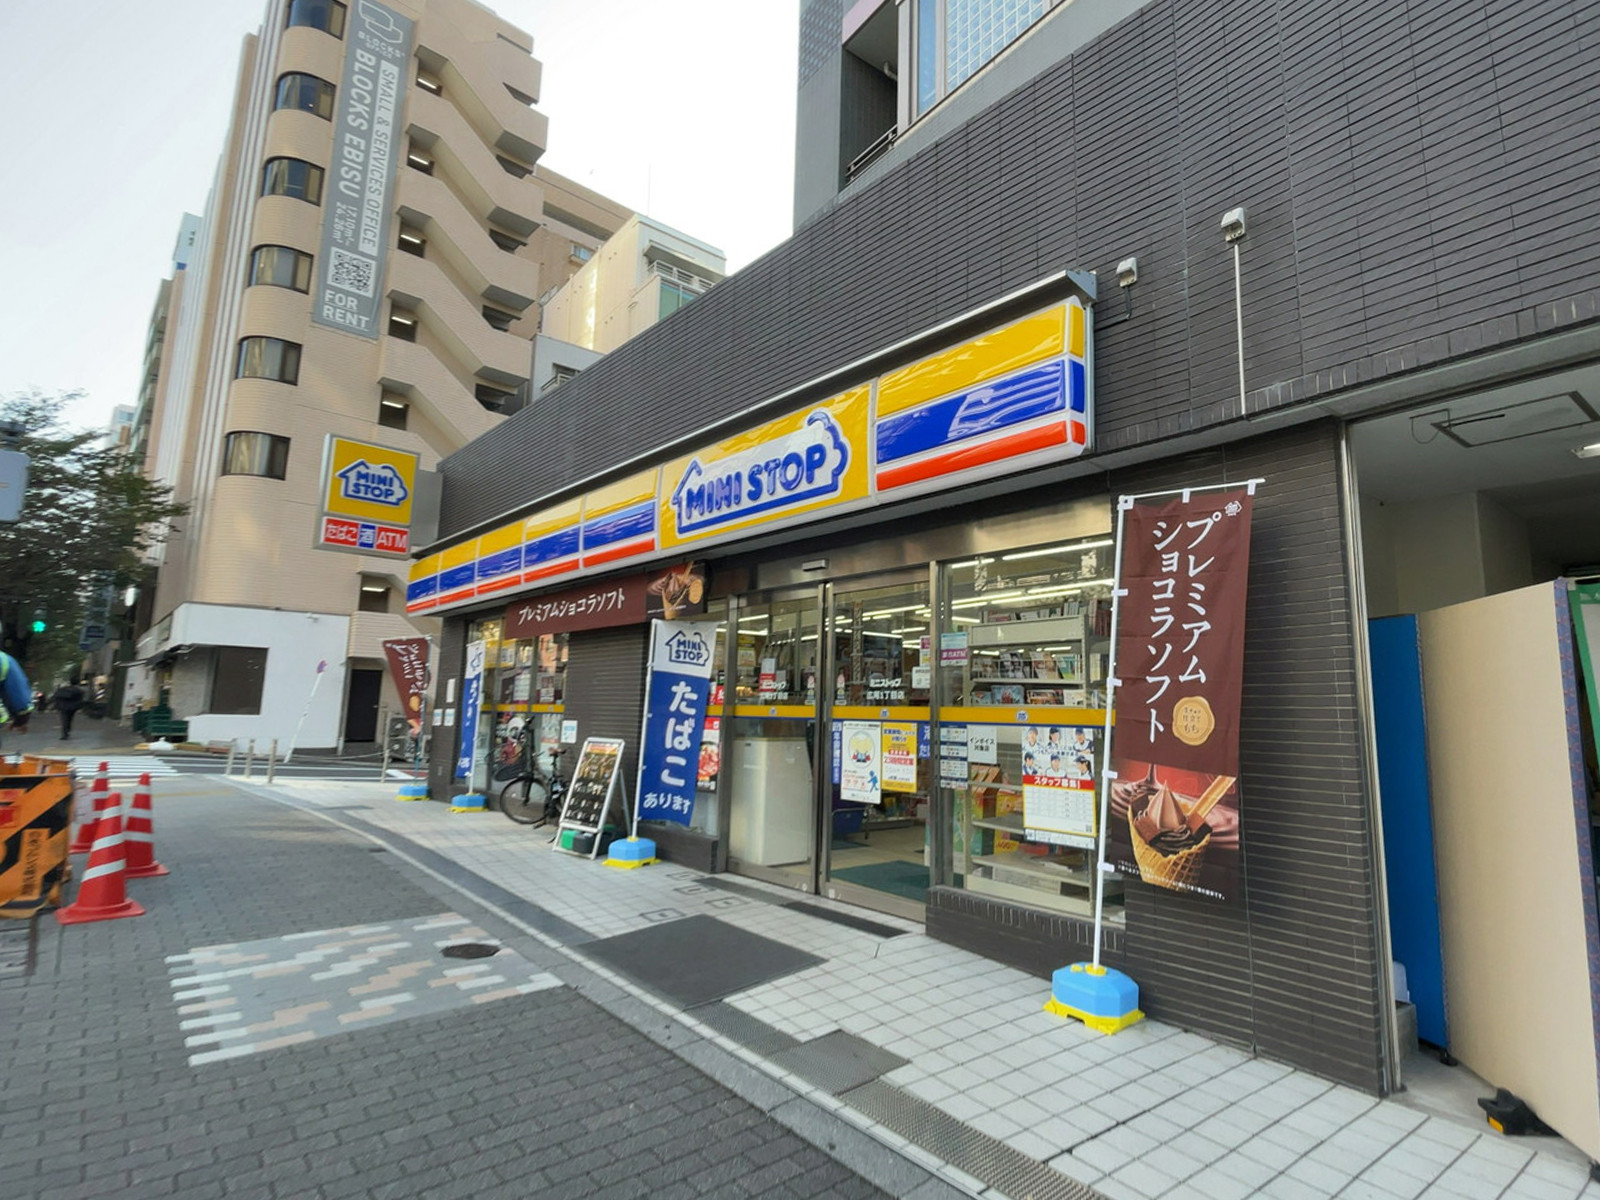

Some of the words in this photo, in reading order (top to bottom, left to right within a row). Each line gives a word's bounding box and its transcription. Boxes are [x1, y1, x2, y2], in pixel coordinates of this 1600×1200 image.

[347, 48, 376, 131] BLOCKS
[378, 69, 395, 112] SMALL
[376, 117, 390, 126] &
[338, 132, 366, 198] EBISU
[368, 130, 389, 197] SERVICES
[362, 198, 380, 247] OFFICE
[322, 305, 370, 328] RENT
[324, 289, 358, 310] FOR
[352, 482, 395, 499] STOP
[356, 470, 394, 487] MINI
[686, 471, 742, 520] MINI
[746, 443, 827, 501] STOP
[325, 523, 357, 542] たばこ
[376, 531, 407, 548] ATM
[518, 587, 625, 625] プレミアムショコラソフト
[1178, 511, 1223, 684] プレミアム
[676, 638, 702, 652] MINI
[1145, 520, 1184, 744] ショコラソフト
[674, 649, 704, 662] STOP
[661, 680, 699, 787] たばこ
[643, 791, 692, 815] あります
